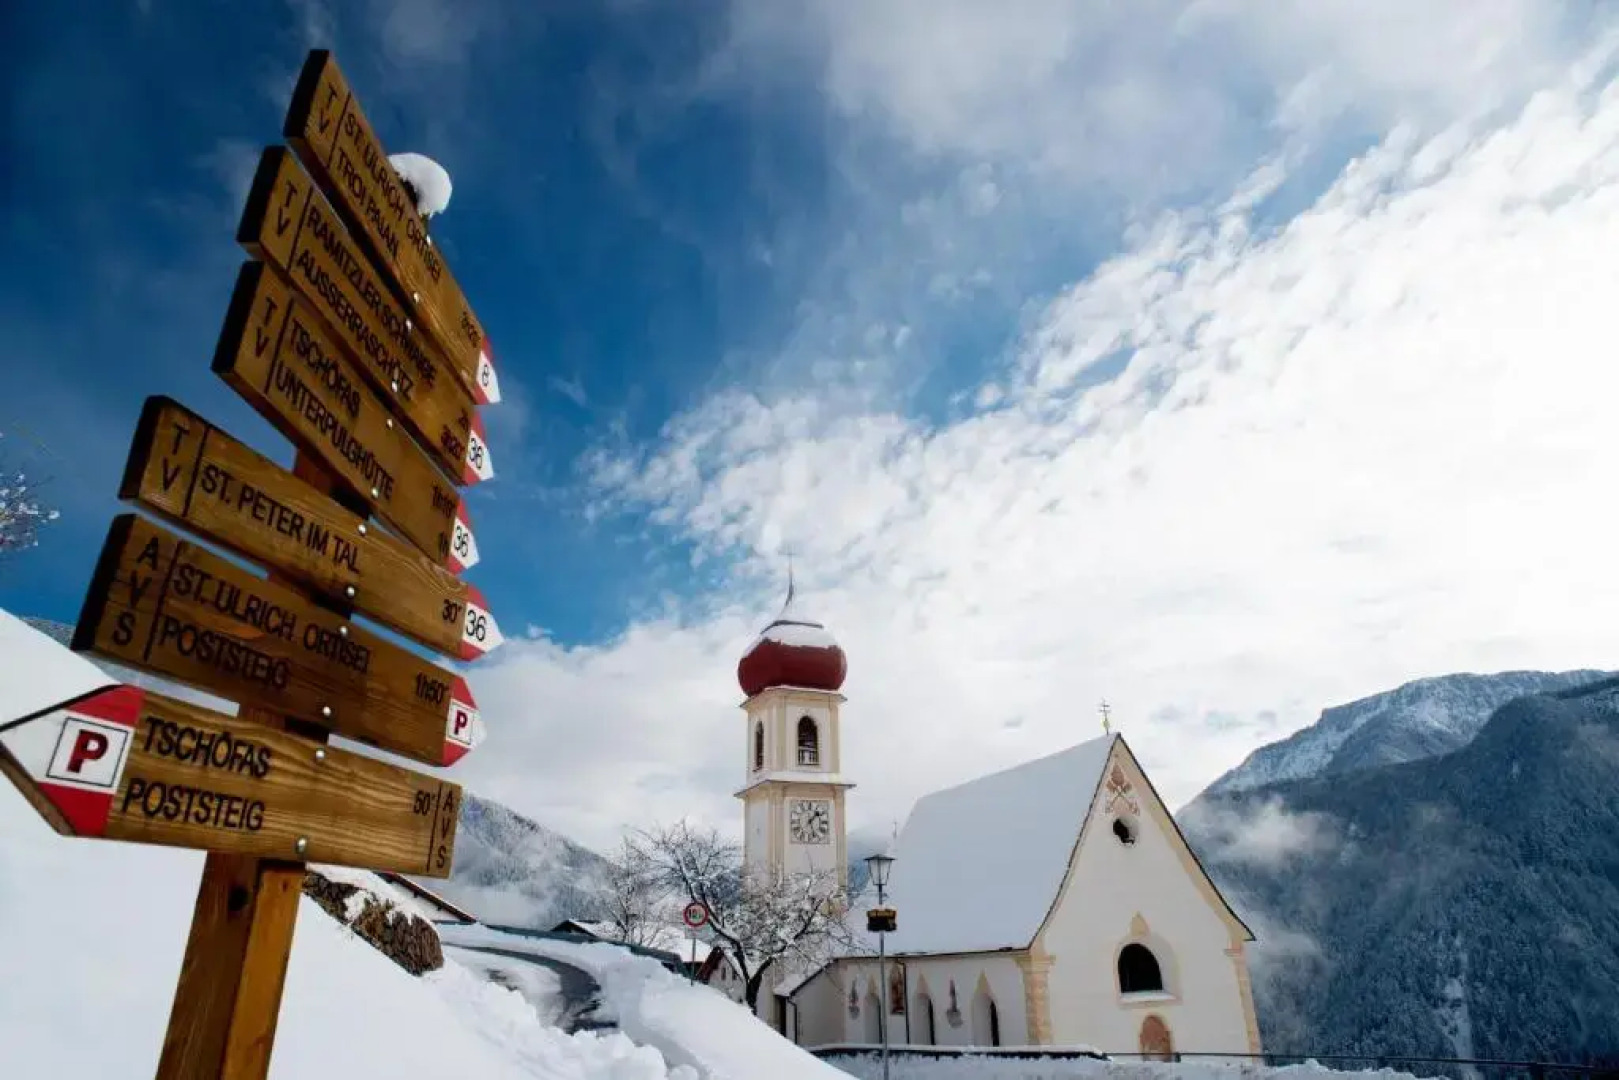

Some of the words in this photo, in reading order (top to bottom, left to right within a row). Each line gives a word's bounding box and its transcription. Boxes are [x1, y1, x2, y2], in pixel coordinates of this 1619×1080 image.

[469, 437, 483, 468] 36
[201, 463, 234, 503] ST.
[238, 485, 305, 541] PETER
[307, 523, 330, 556] IM
[333, 535, 361, 574] TAL
[454, 525, 468, 557] 36
[465, 609, 487, 641] 36
[158, 614, 291, 690] POSTSTEIG
[454, 709, 468, 735] P
[67, 728, 109, 773] P
[144, 716, 272, 779] TSCHÖFAS
[121, 778, 266, 831] POSTSTEIG
